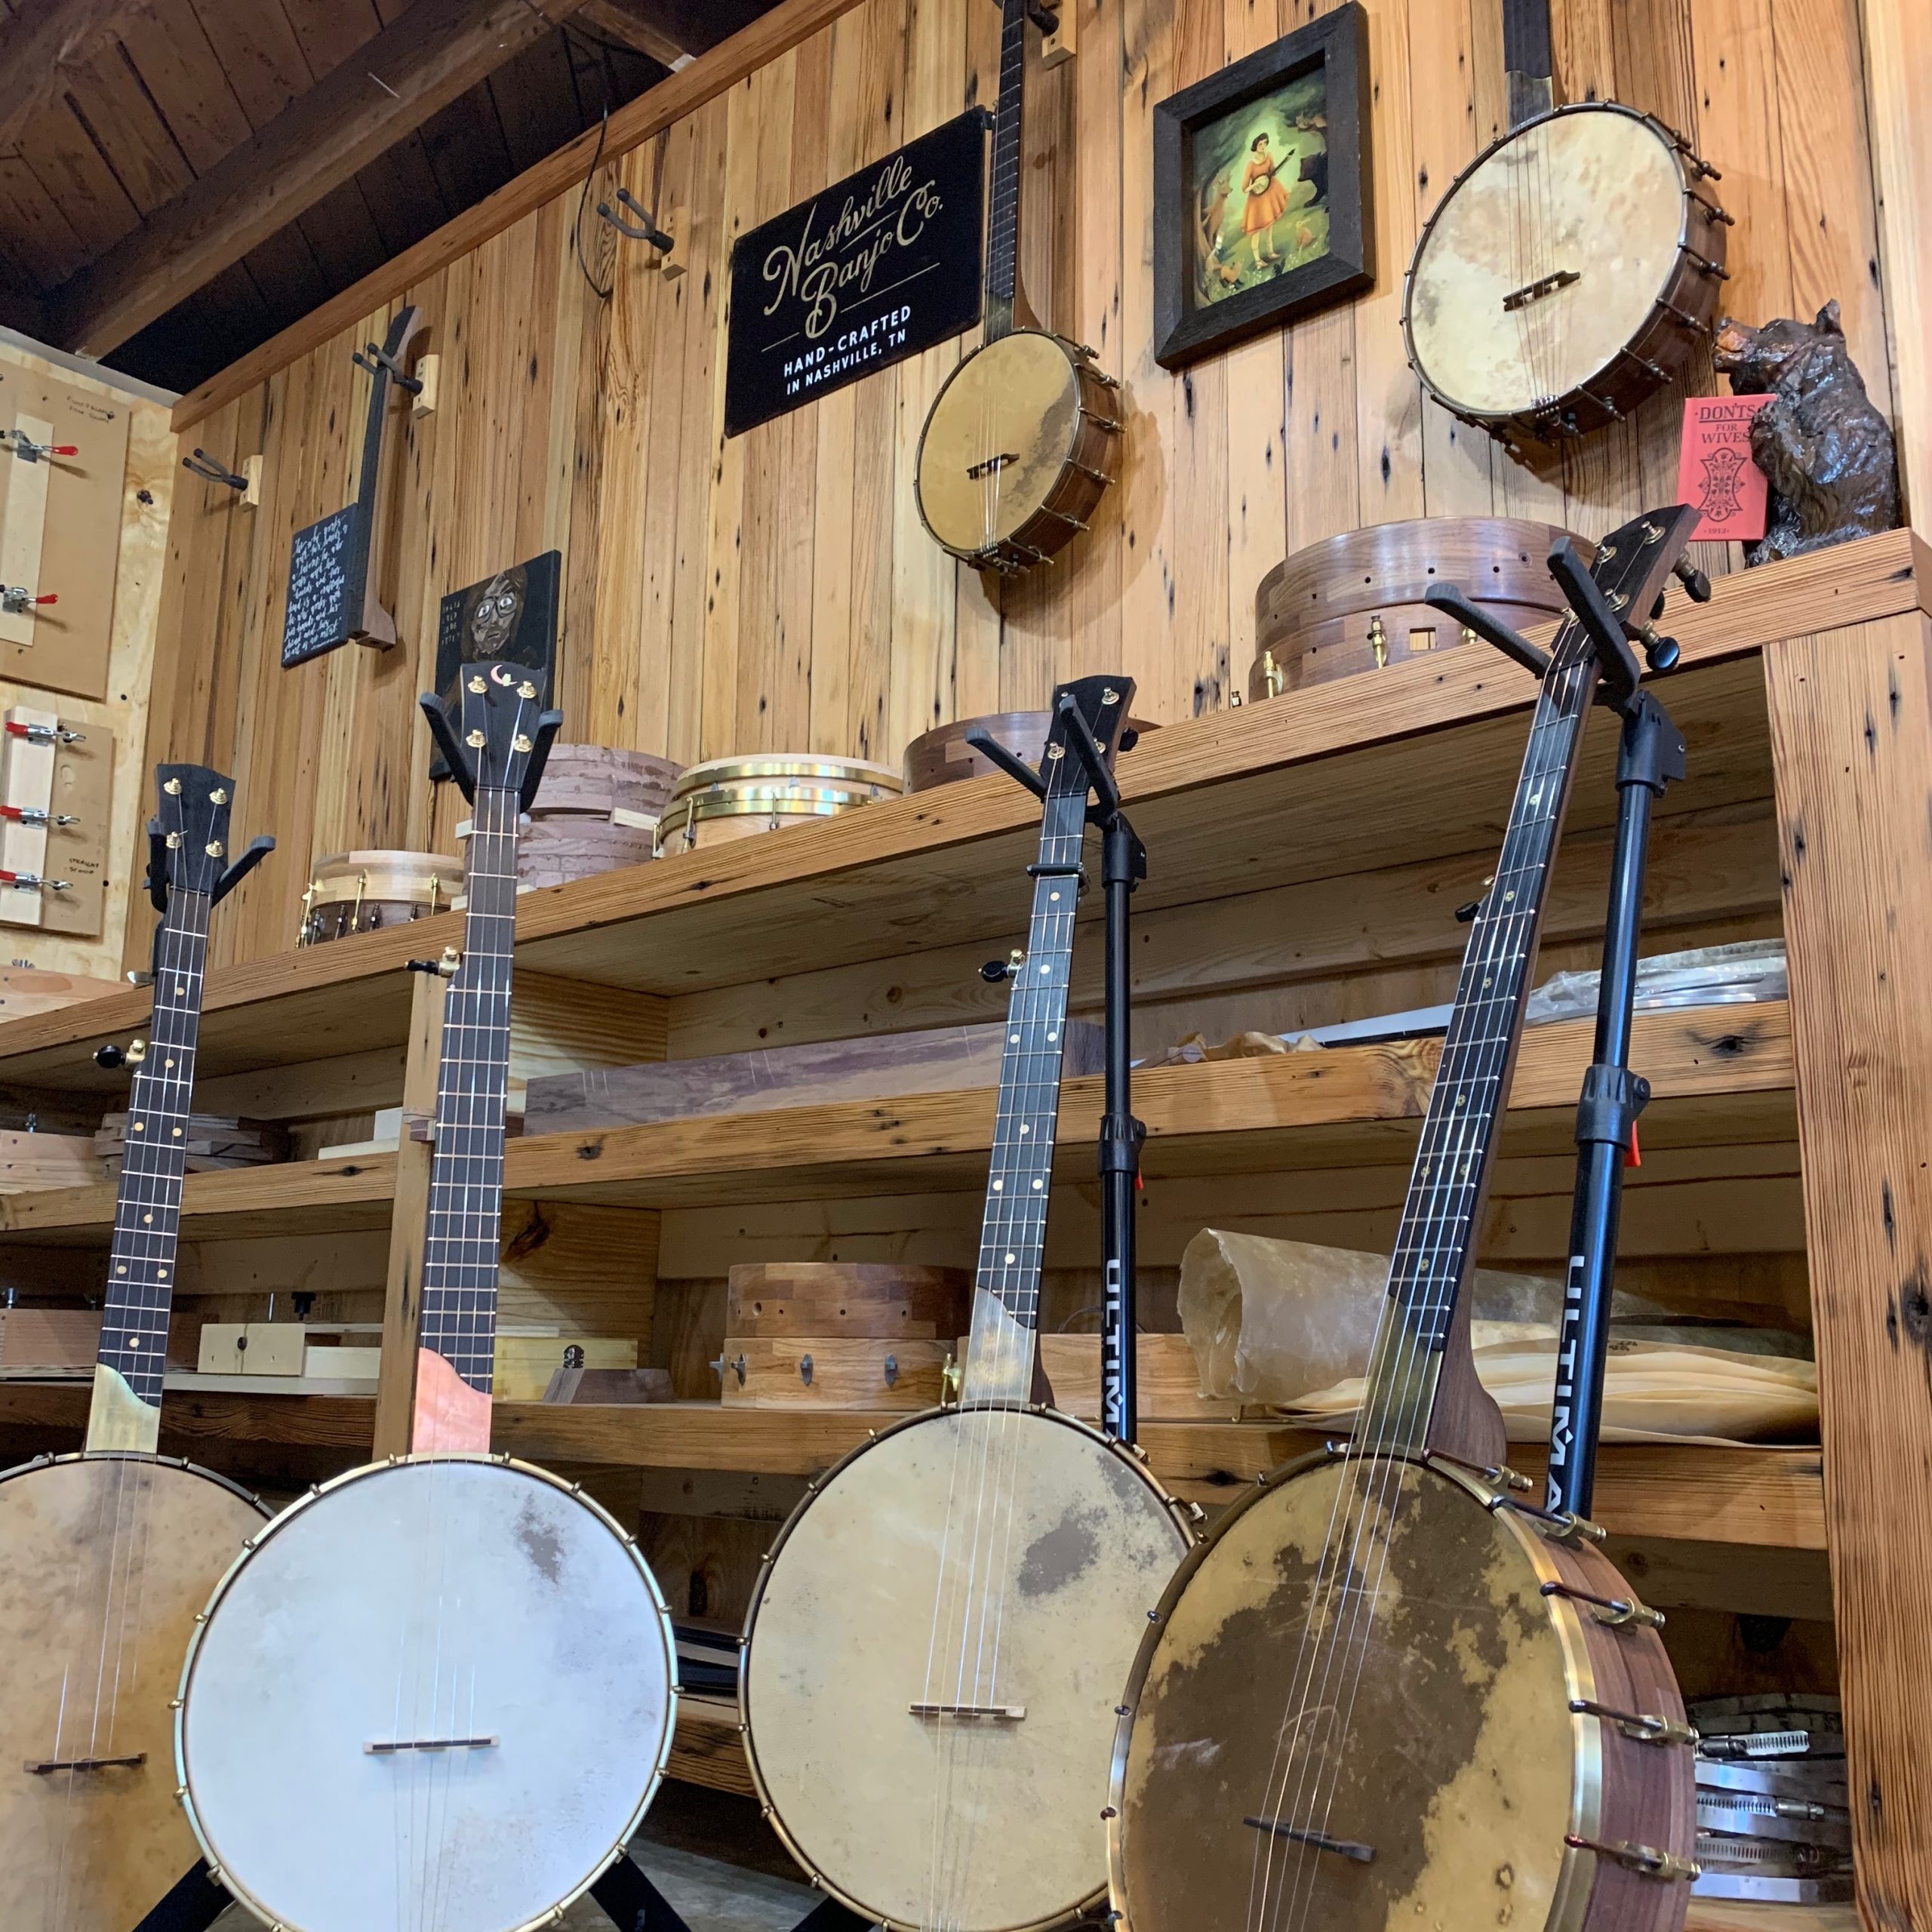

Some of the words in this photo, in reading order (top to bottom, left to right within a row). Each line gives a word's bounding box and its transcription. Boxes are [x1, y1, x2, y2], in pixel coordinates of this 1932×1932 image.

[762, 155, 912, 316] Nashville
[801, 232, 892, 340] Banjo
[897, 179, 943, 248] Co.
[783, 305, 912, 378] HAND-CRAFTED
[786, 377, 800, 395] IN
[805, 343, 882, 386] NASHVILLE,
[888, 330, 906, 349] TN
[1700, 403, 1755, 420] DON'TS
[1702, 432, 1751, 445] WIVES
[1715, 423, 1738, 432] FOR
